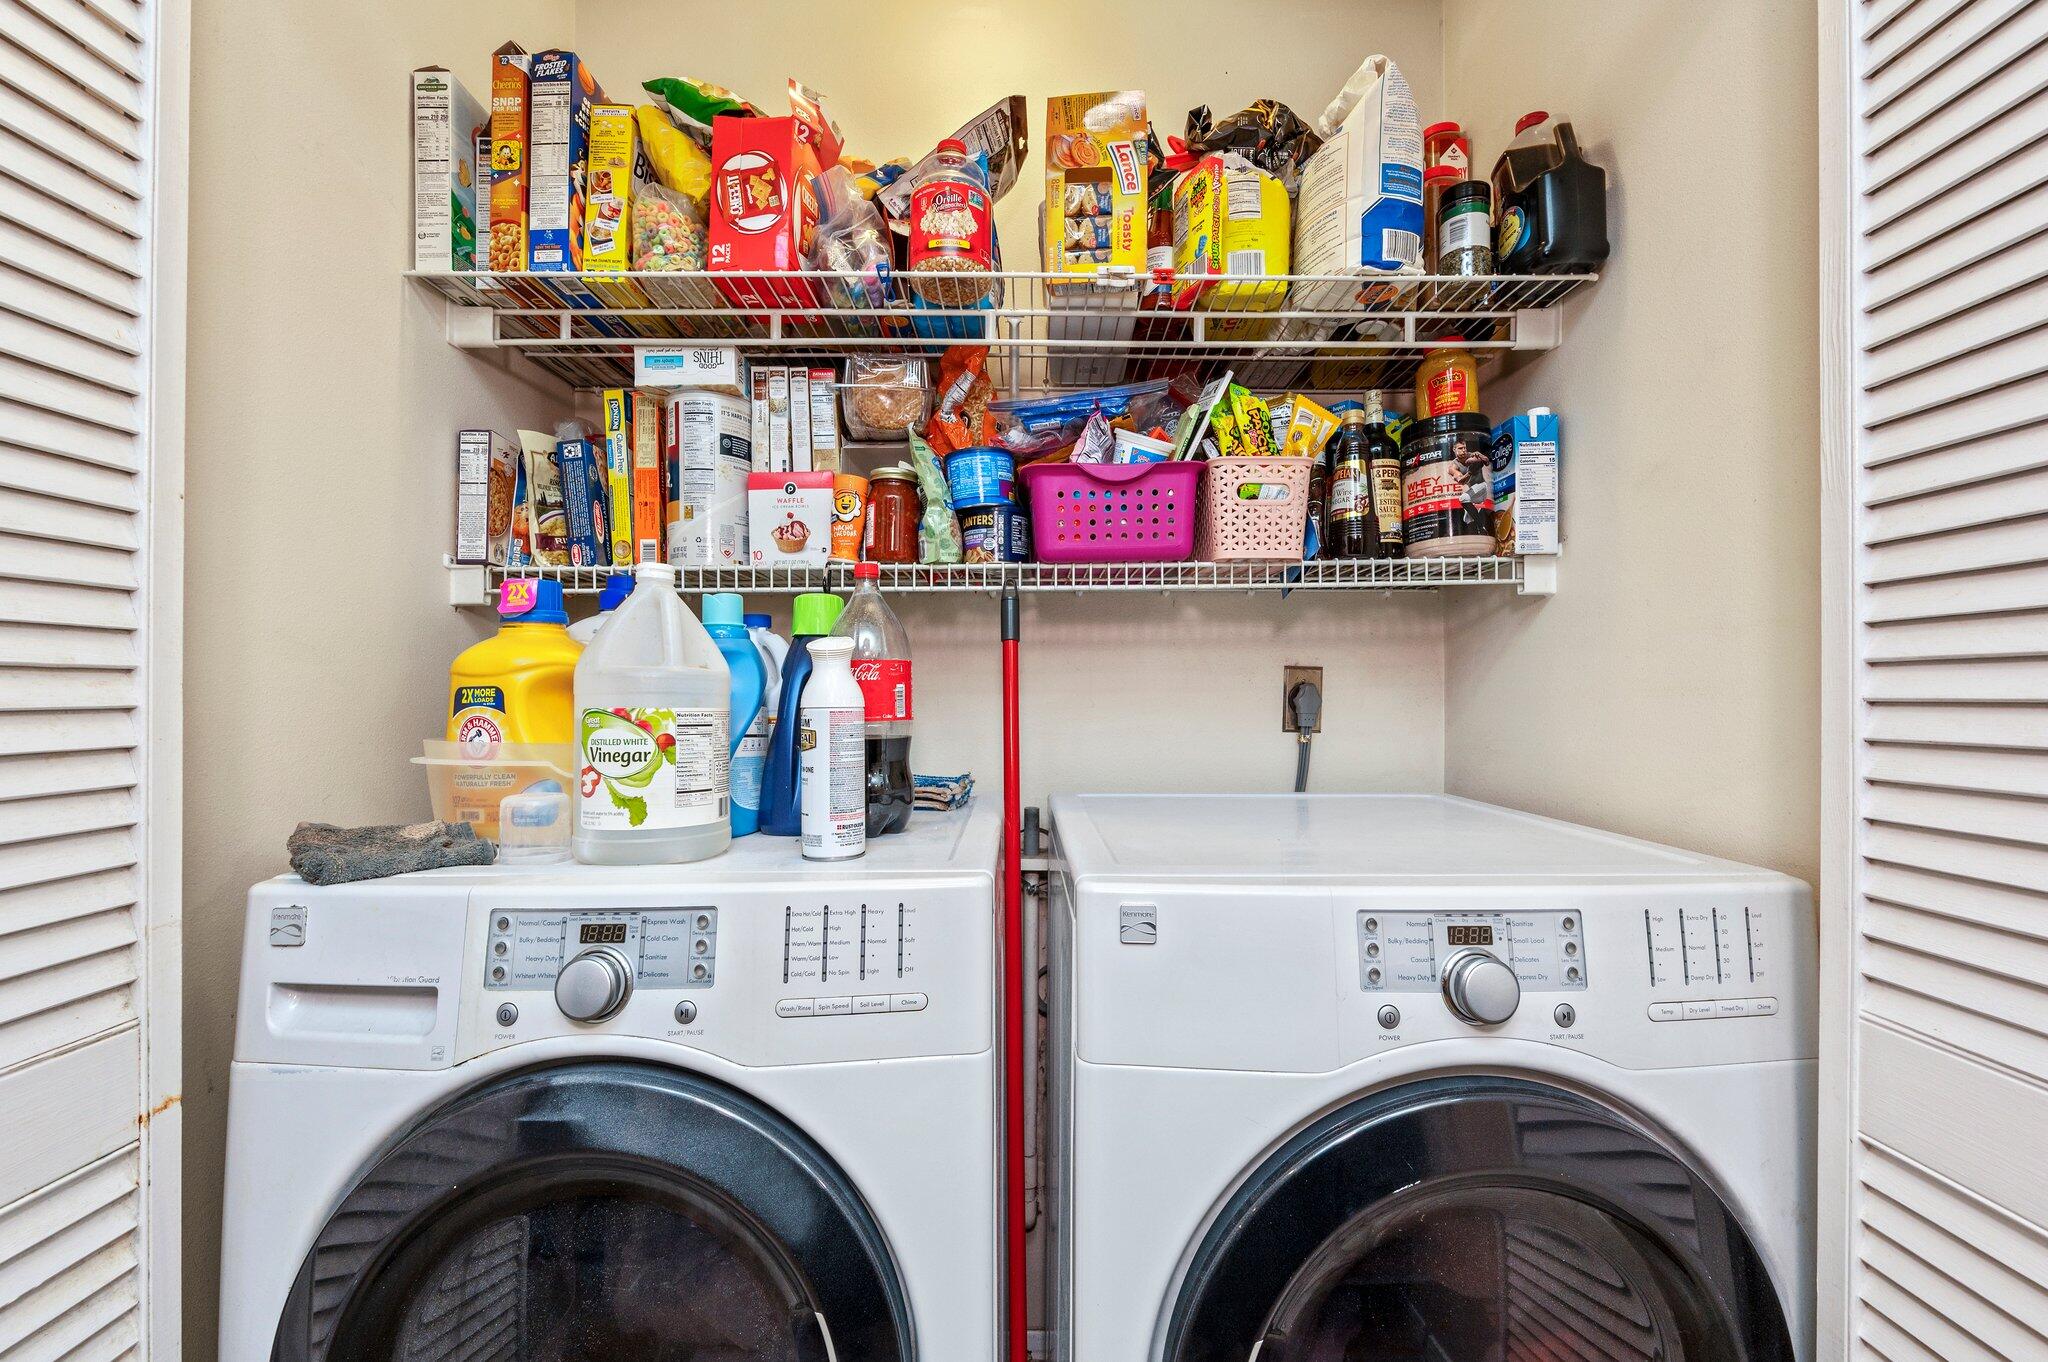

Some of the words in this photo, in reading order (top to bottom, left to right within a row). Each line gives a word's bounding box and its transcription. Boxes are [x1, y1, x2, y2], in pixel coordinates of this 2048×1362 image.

[534, 60, 567, 71] FROSTED
[492, 80, 522, 90] Cheerios
[493, 97, 522, 106] SNAP
[1115, 144, 1137, 191] Lance
[936, 194, 963, 206] Orville
[1122, 206, 1134, 251] Toasty
[1212, 214, 1220, 242] PATCH
[712, 244, 726, 264] 12
[1212, 243, 1220, 270] SOUR
[692, 350, 724, 366] THINS
[698, 362, 718, 370] GOOD
[610, 400, 620, 431] RONZONI
[616, 433, 624, 456] Gluten
[1420, 450, 1442, 461] STAR
[1496, 458, 1507, 469] Inn
[1376, 470, 1382, 478] &
[1408, 476, 1440, 492] WHEY
[1408, 484, 1462, 502] ISOLATE
[834, 530, 858, 538] CHEDDAR
[752, 550, 762, 560] 10
[508, 582, 530, 600] 2X
[462, 688, 474, 704] 2X
[474, 688, 496, 696] MORE
[473, 719, 499, 743] HAMME
[590, 738, 622, 746] DISTILLED
[623, 738, 648, 746] WHITE
[590, 747, 651, 767] Vinegar
